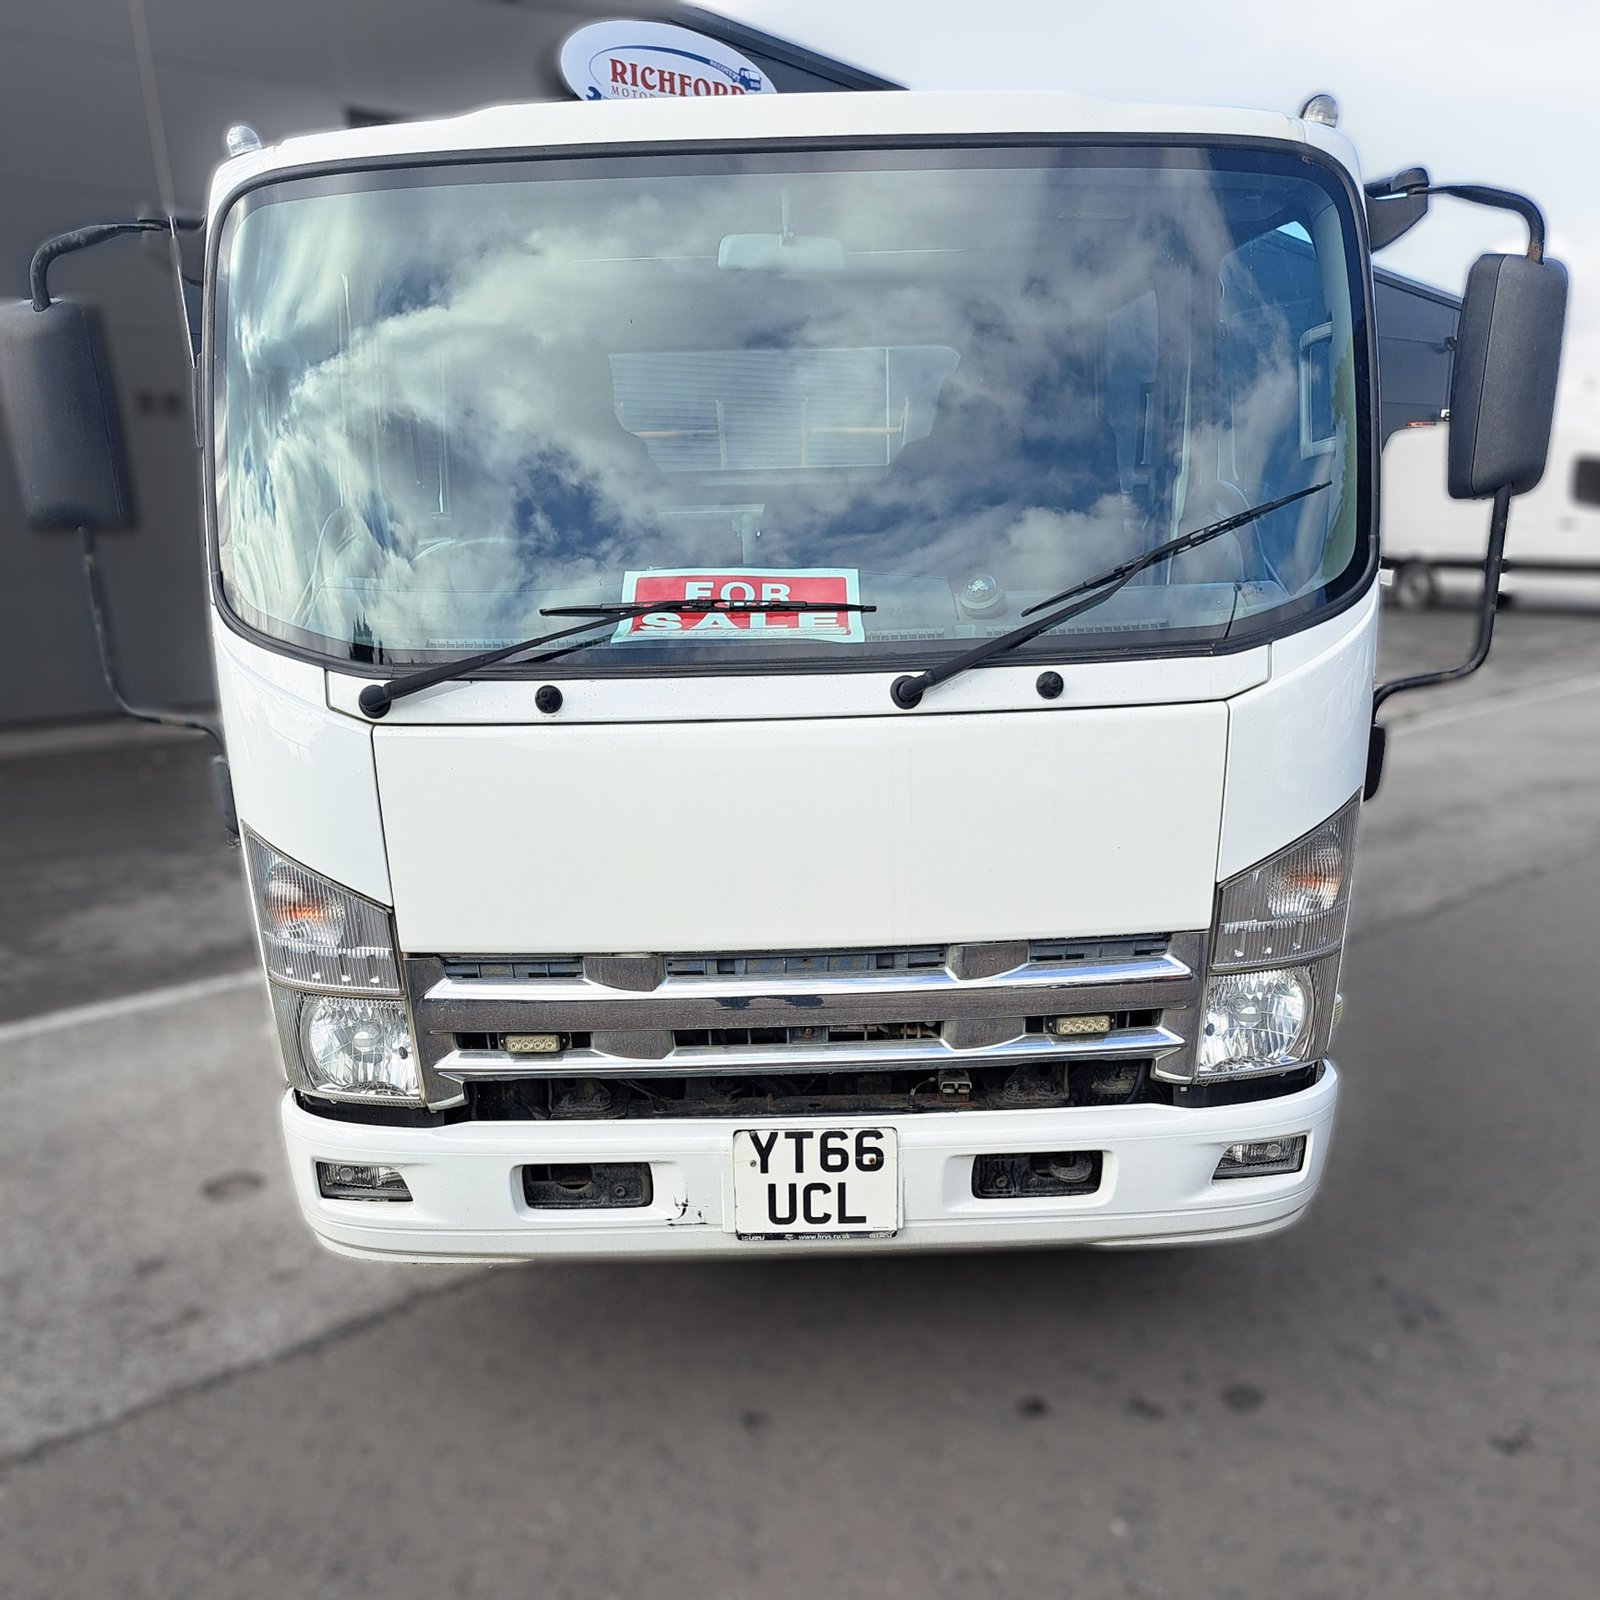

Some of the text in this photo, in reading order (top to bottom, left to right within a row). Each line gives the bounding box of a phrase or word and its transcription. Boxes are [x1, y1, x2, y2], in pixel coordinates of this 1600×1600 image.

[685, 581, 791, 606] FOR
[638, 611, 840, 631] SALE
[750, 1130, 884, 1174] YT66
[768, 1182, 867, 1225] UCL
